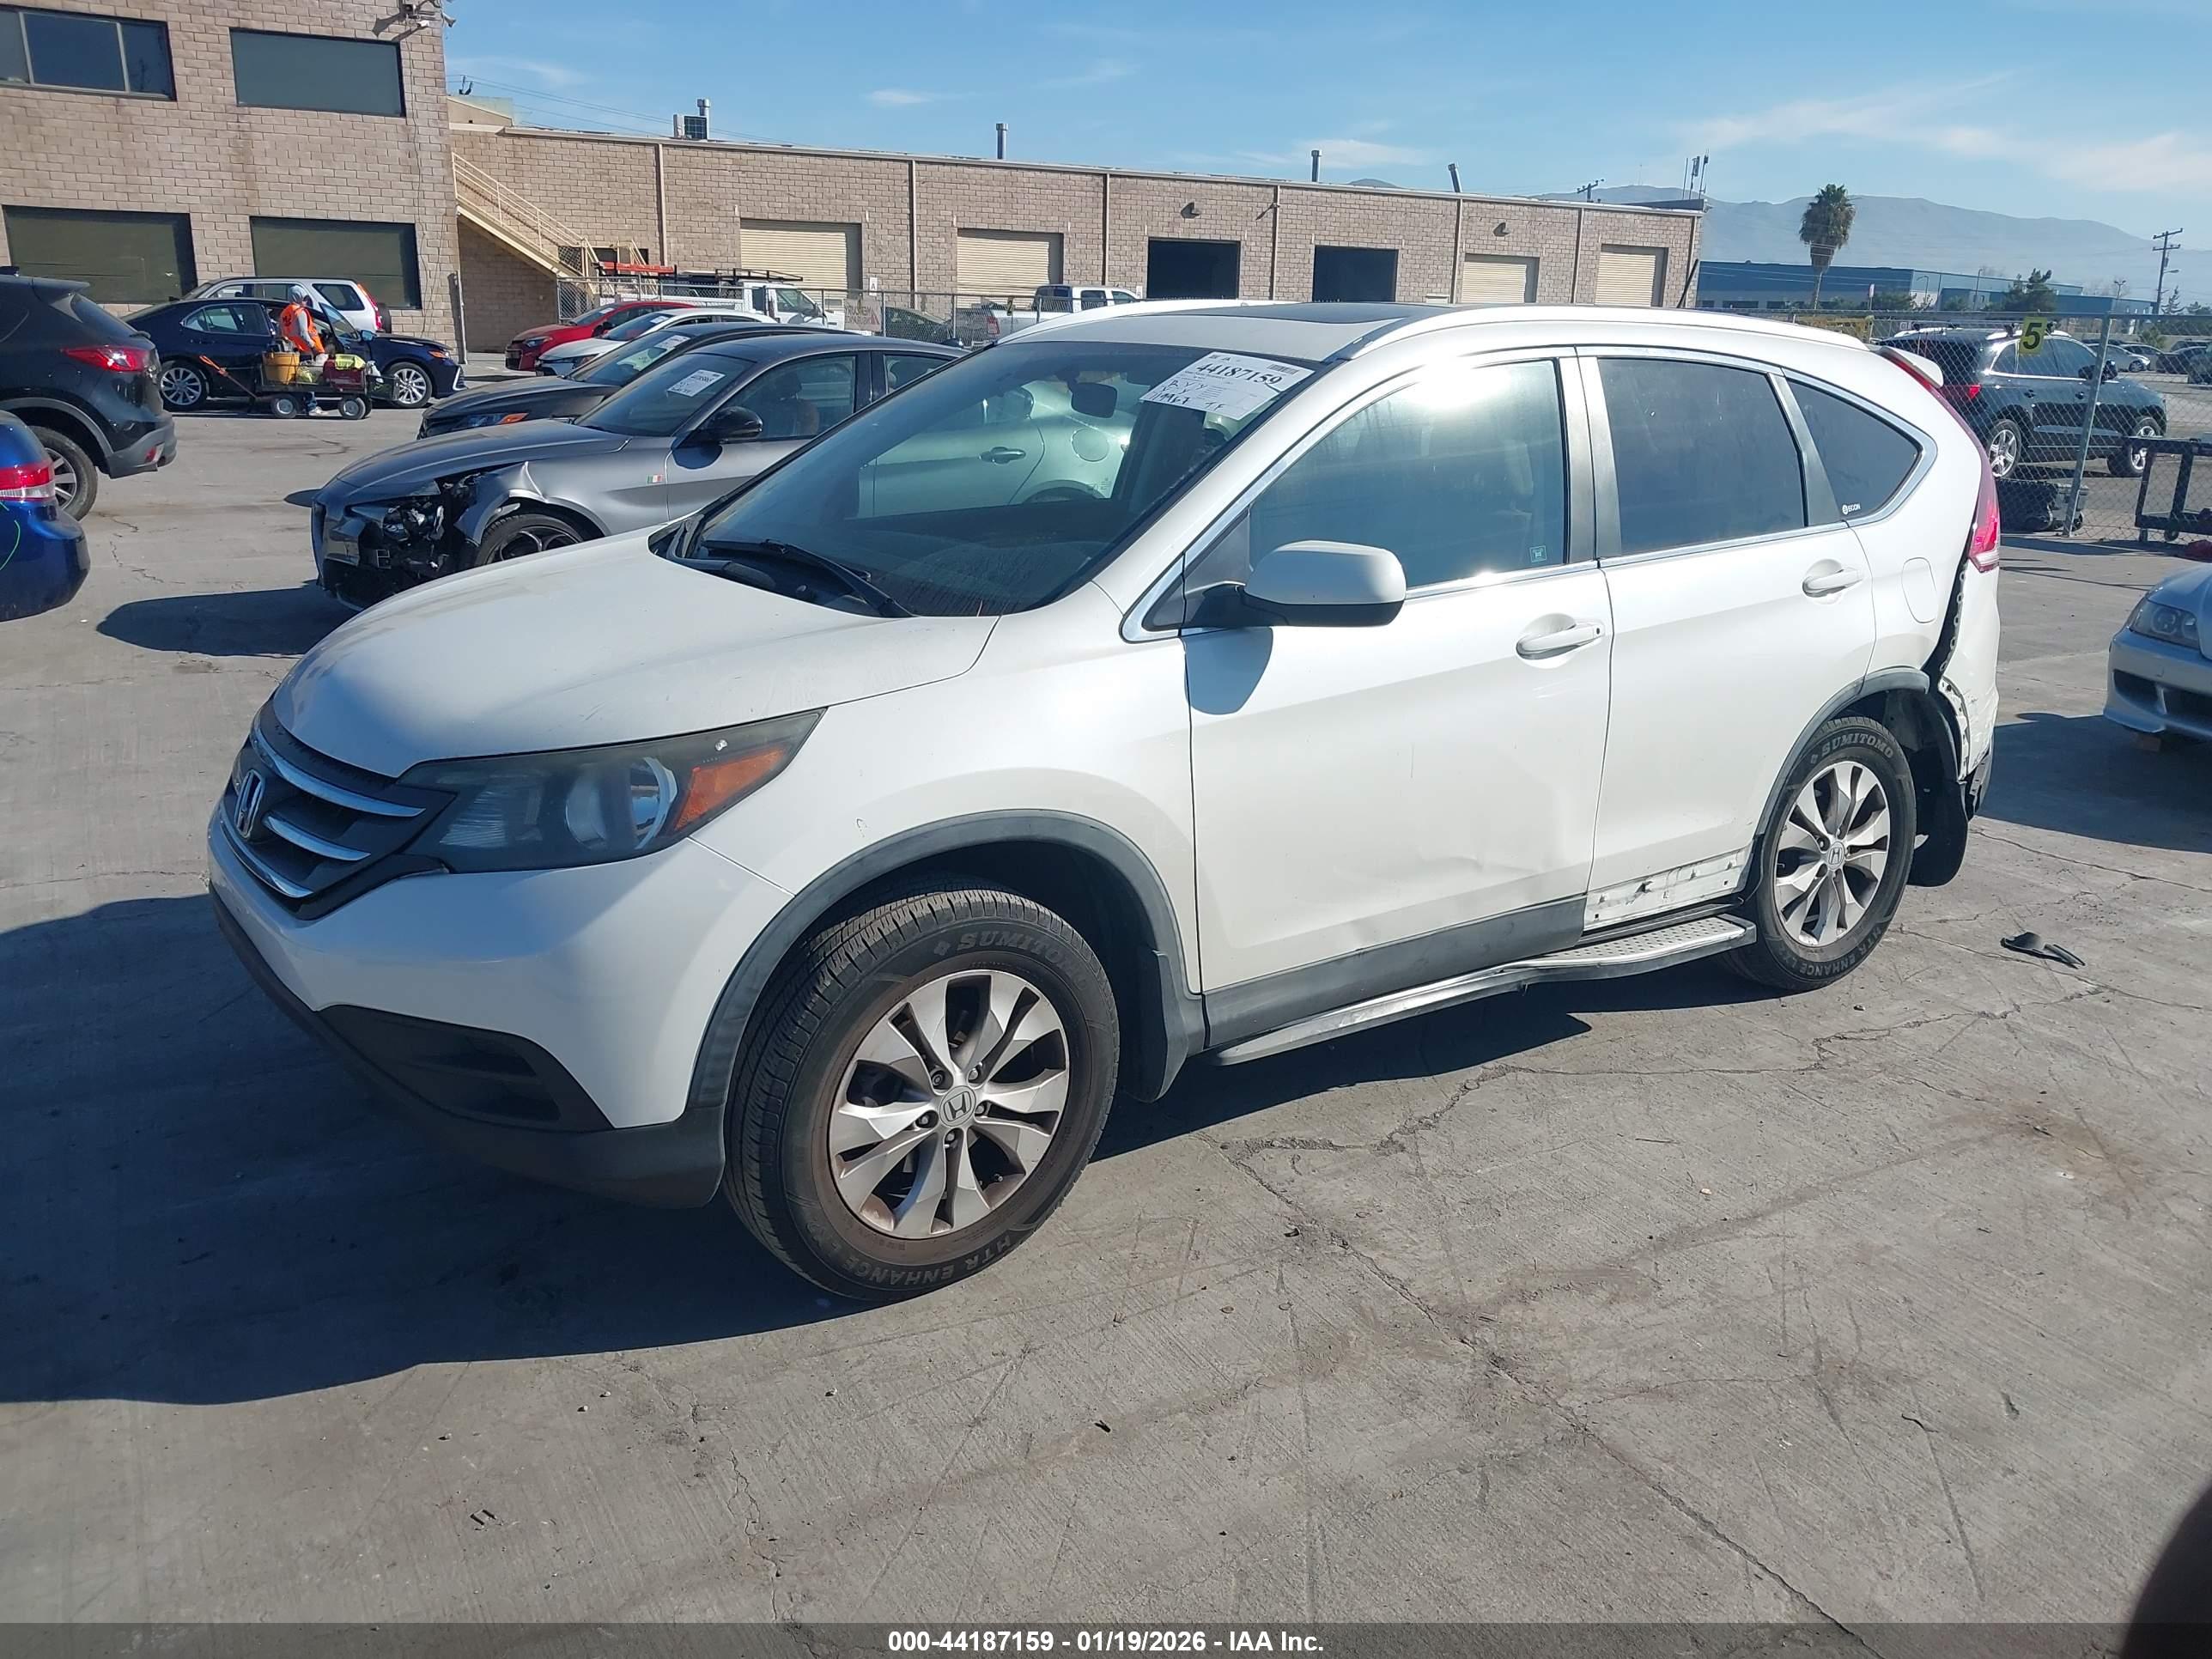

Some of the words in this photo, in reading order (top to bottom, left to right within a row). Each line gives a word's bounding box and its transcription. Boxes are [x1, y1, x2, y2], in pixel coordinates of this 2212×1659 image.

[2022, 322, 2043, 349] 5
[1196, 362, 1283, 385] 44187159
[1820, 732, 1894, 759] SUMITOMO
[957, 930, 1088, 991] SUMITOMO
[1798, 954, 1856, 976] ENHANCE
[963, 1235, 1012, 1271] HTR
[842, 1257, 955, 1286] ENHANCE
